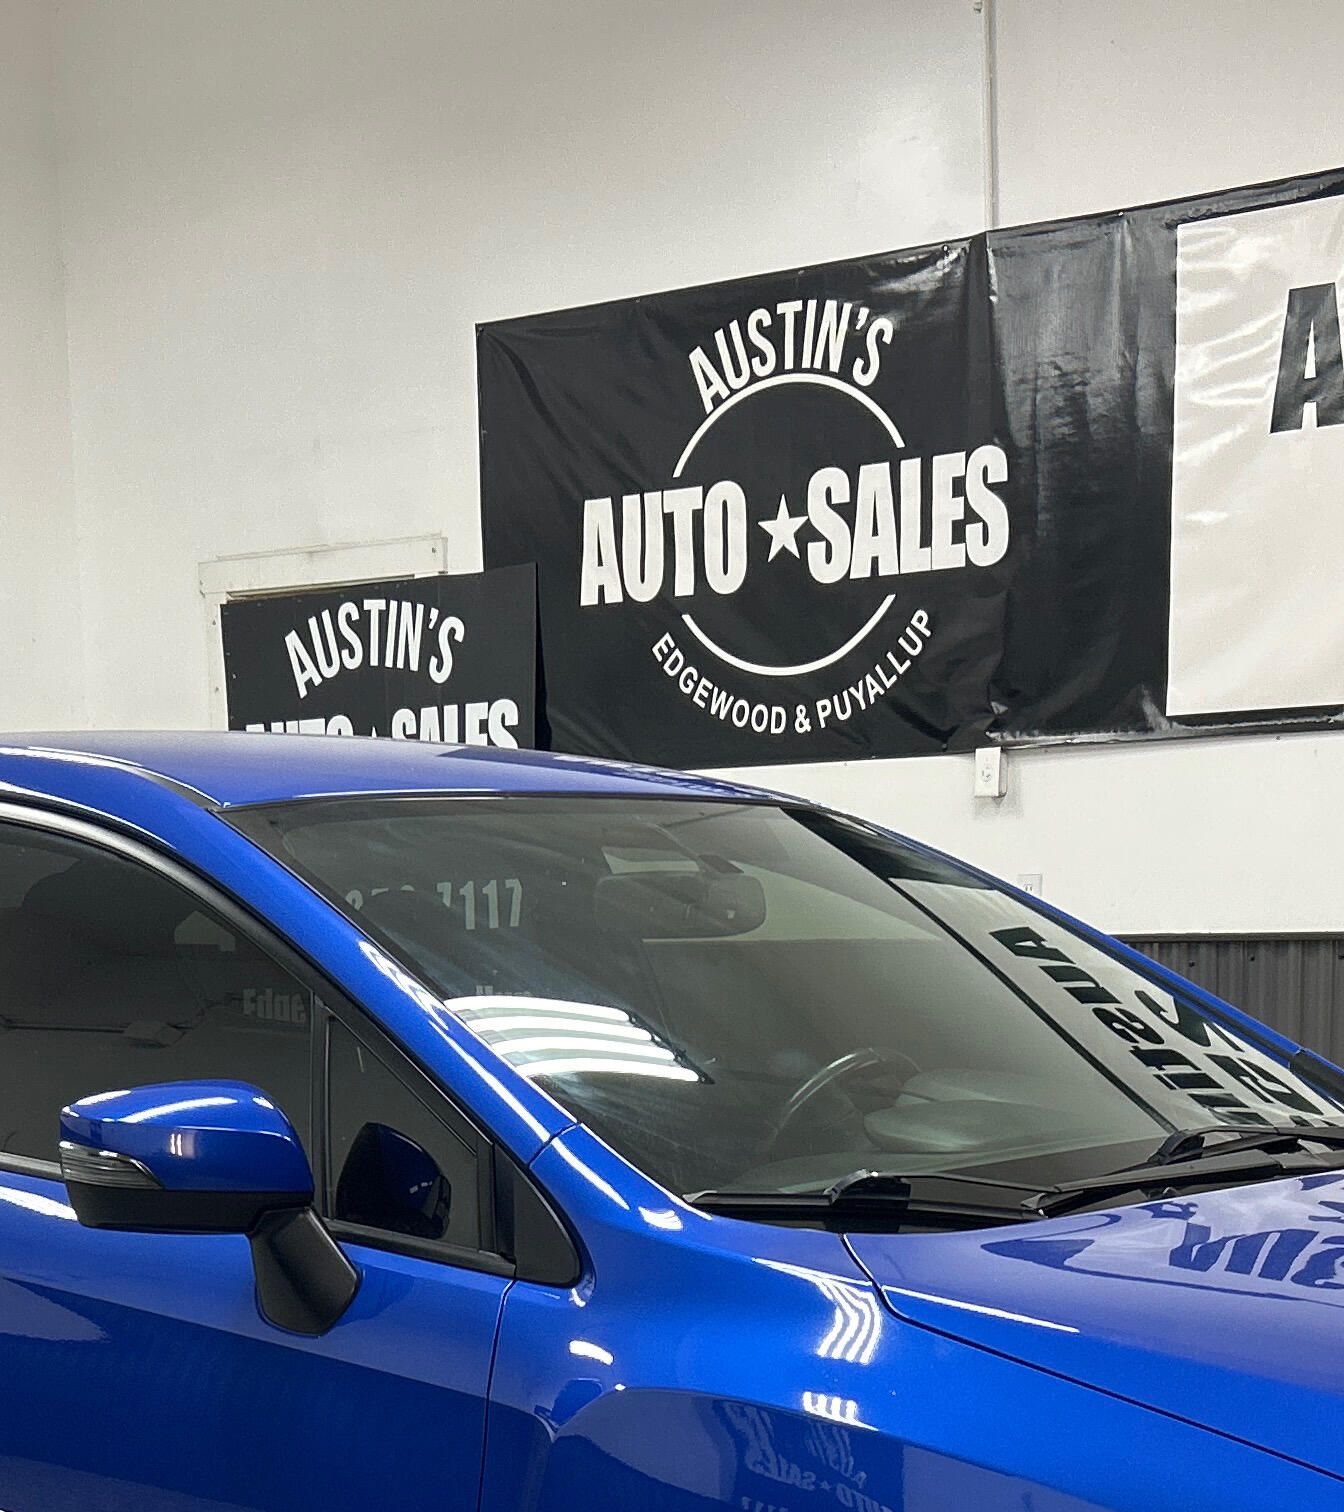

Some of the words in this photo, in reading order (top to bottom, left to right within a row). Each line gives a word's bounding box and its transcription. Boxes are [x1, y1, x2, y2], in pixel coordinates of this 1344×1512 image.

[687, 298, 894, 412] AUSTIN'S
[579, 480, 747, 607] AUTO
[807, 445, 1009, 584] SALES
[285, 599, 464, 699] AUSTIN'S
[652, 632, 786, 734] EDGEWOOD
[795, 705, 812, 734] &
[816, 609, 932, 728] PUYALLUP
